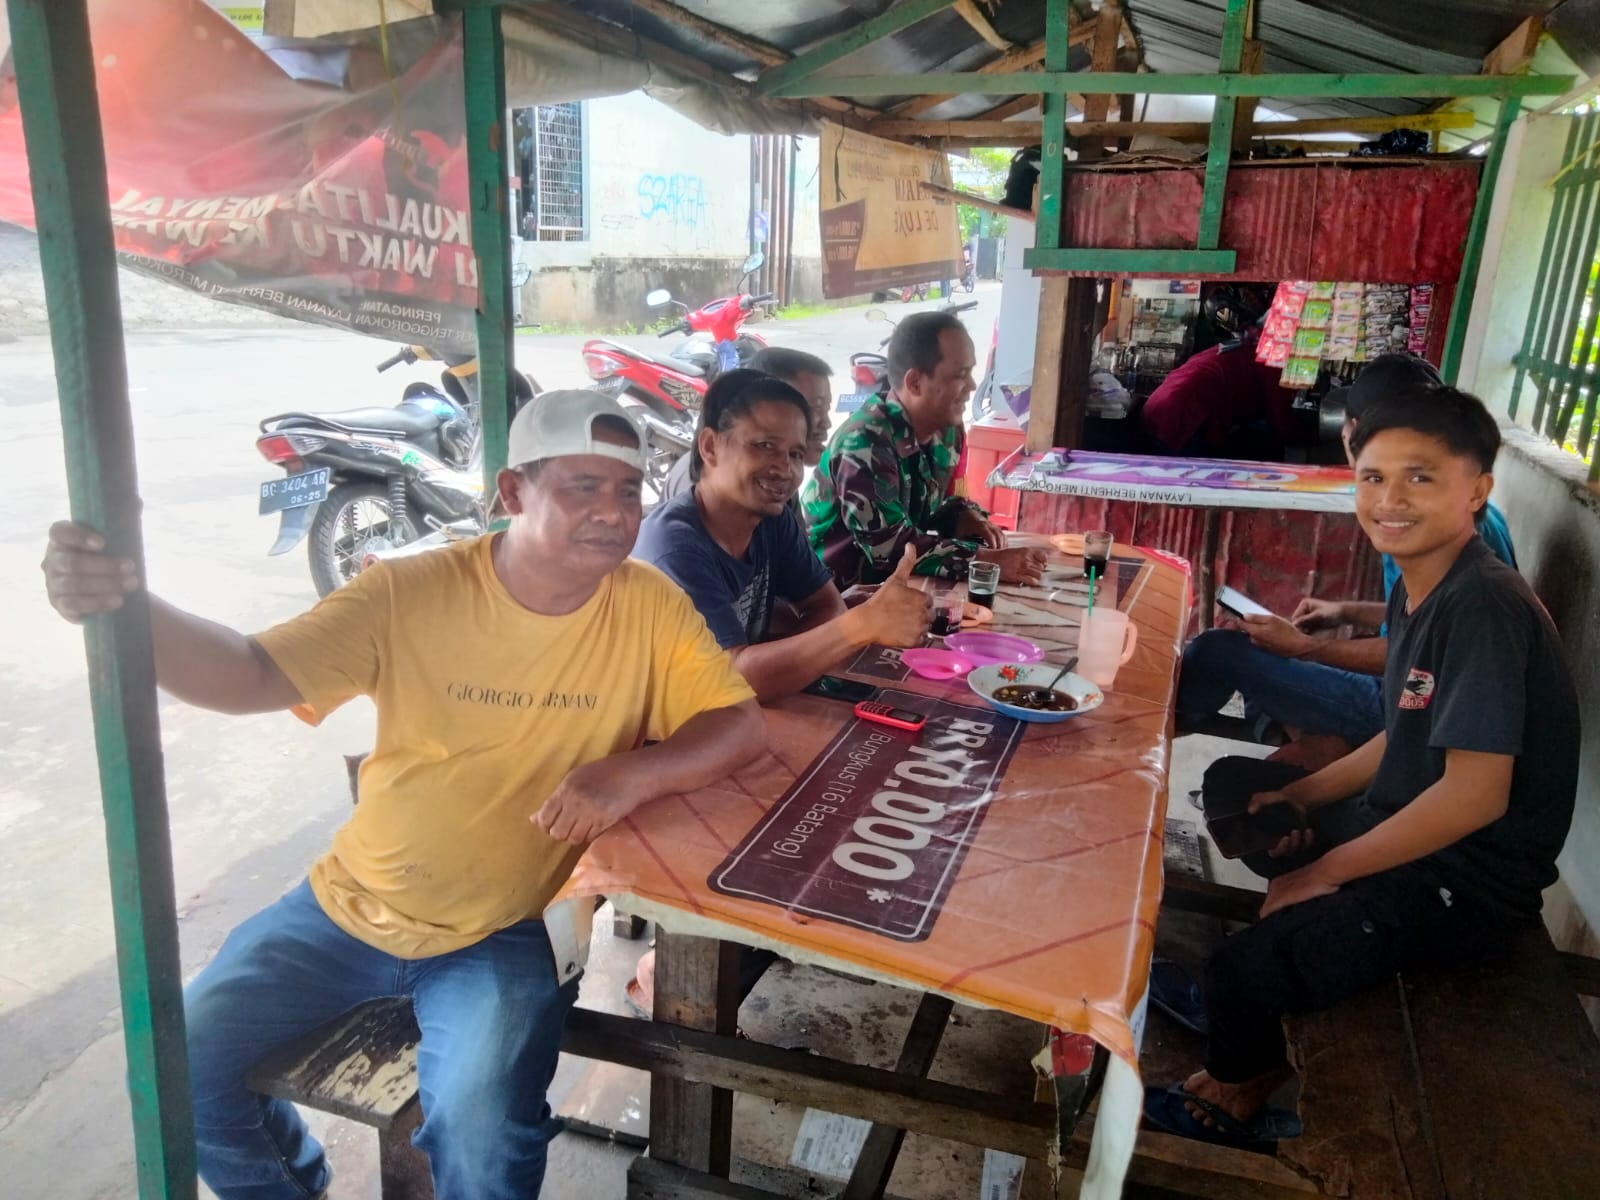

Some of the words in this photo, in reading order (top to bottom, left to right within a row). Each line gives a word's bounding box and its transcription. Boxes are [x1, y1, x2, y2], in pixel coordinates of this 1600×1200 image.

[1080, 487, 1136, 499] BERHENTI
[1140, 491, 1192, 503] LAYANAN
[447, 681, 534, 710] GIORGIO
[838, 727, 896, 782] /Bungkus
[821, 779, 857, 804] (16
[770, 802, 839, 859] Batang)
